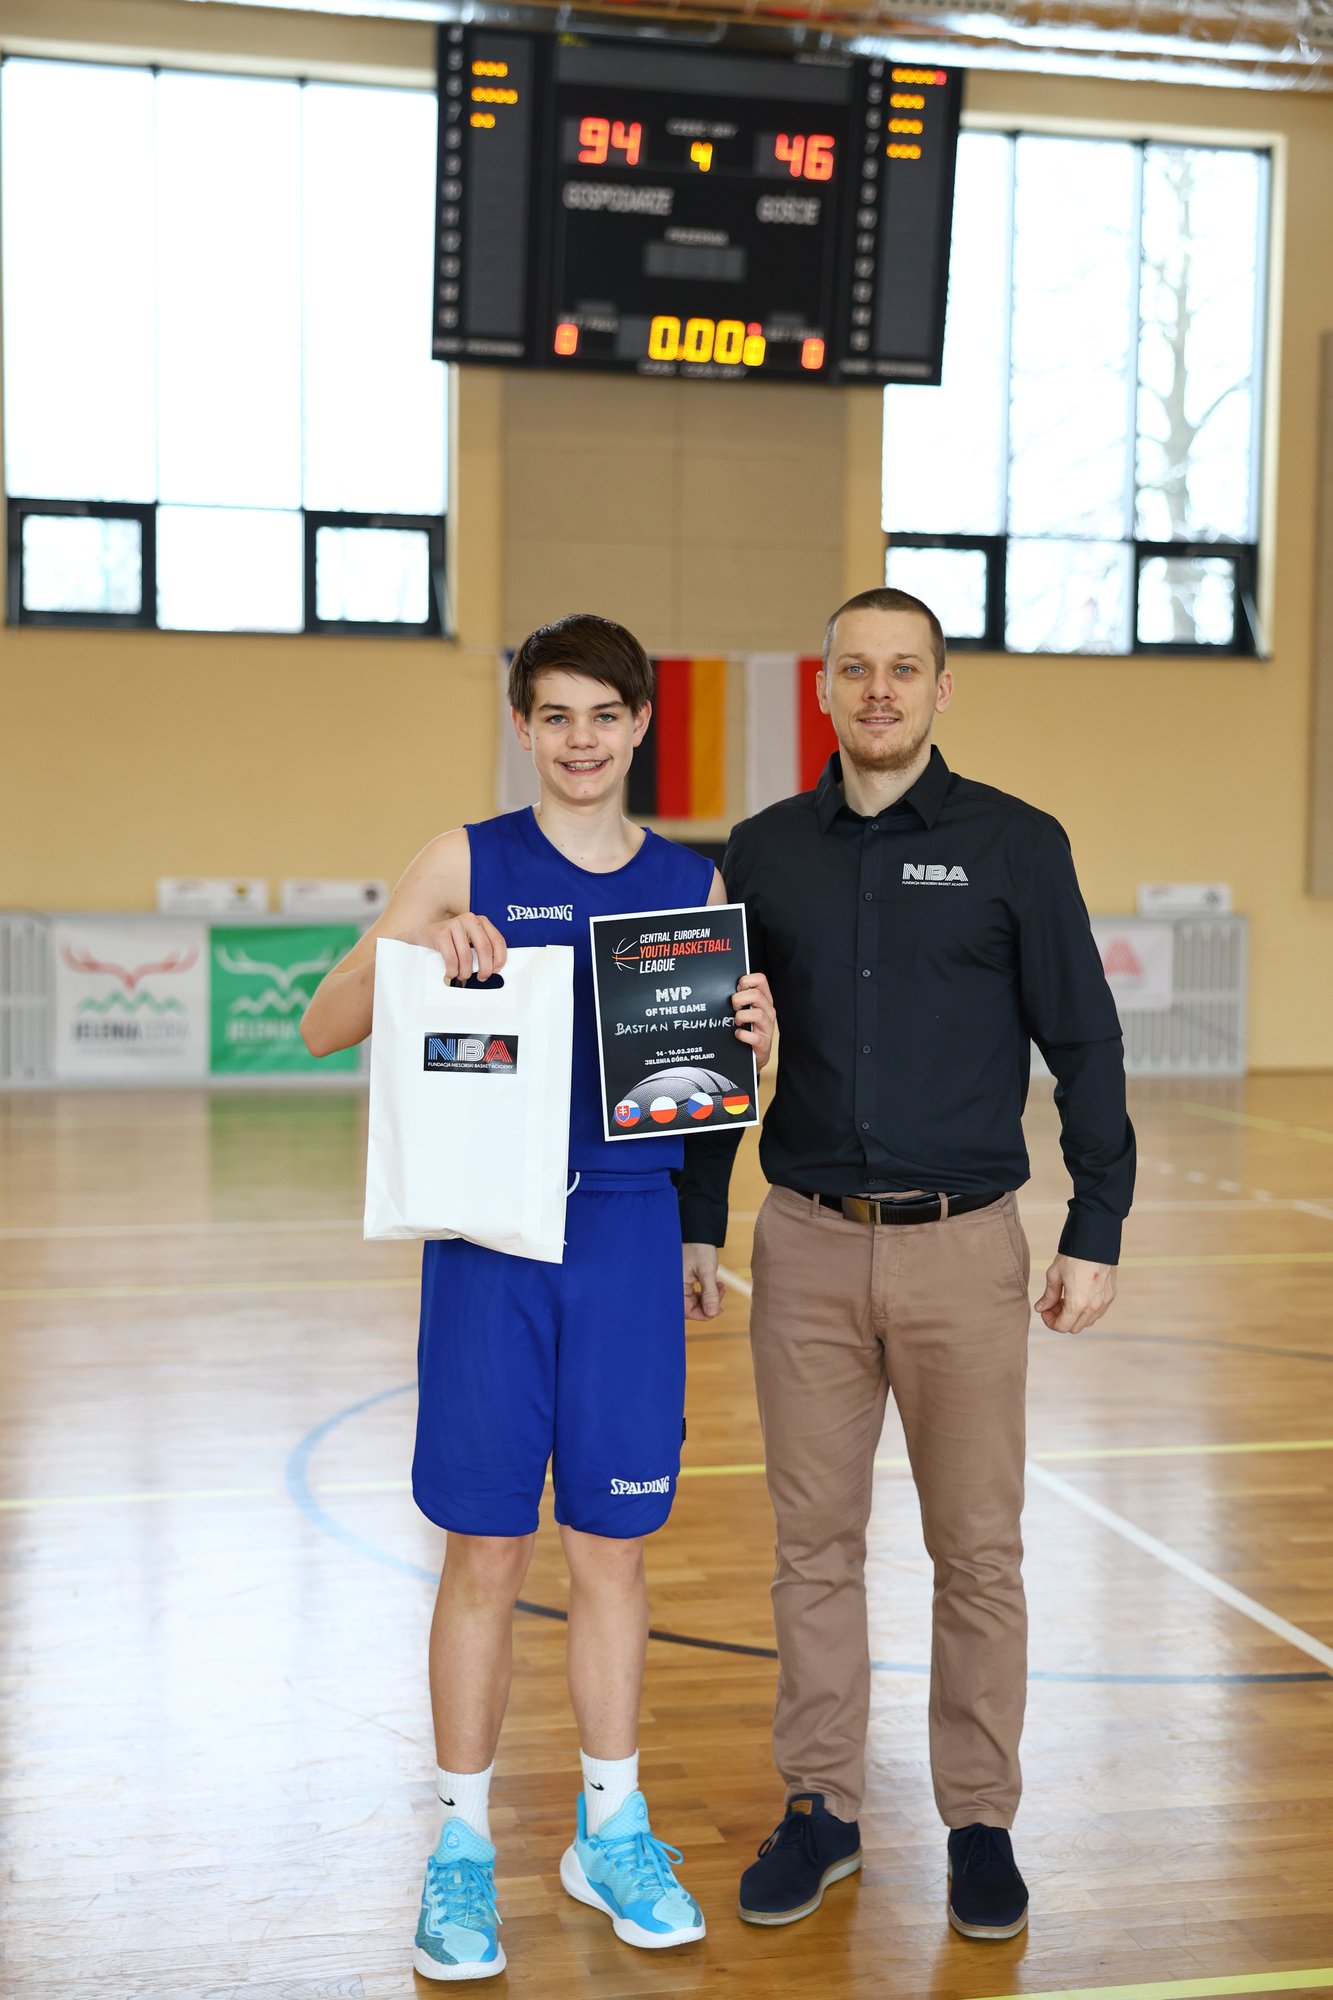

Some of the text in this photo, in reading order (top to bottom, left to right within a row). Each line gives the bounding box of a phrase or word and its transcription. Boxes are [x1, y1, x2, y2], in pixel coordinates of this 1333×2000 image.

[578, 117, 642, 166] 94
[690, 141, 713, 173] 4
[775, 133, 835, 181] 46
[902, 863, 969, 882] NBA
[507, 904, 573, 921] SPALDING
[640, 928, 711, 944] CENTRAL EUROPEAN
[640, 938, 732, 959] YOUTH BASKETBALL
[639, 958, 676, 974] LEAGUE
[655, 986, 692, 1002] MVP
[645, 1003, 707, 1017] OF THE GAME
[614, 1022, 669, 1036] BASTIAN
[428, 1038, 513, 1063] NBA
[644, 1052, 715, 1066] JELENIA GÓRA, POLAND
[610, 1475, 670, 1495] SPALDING
